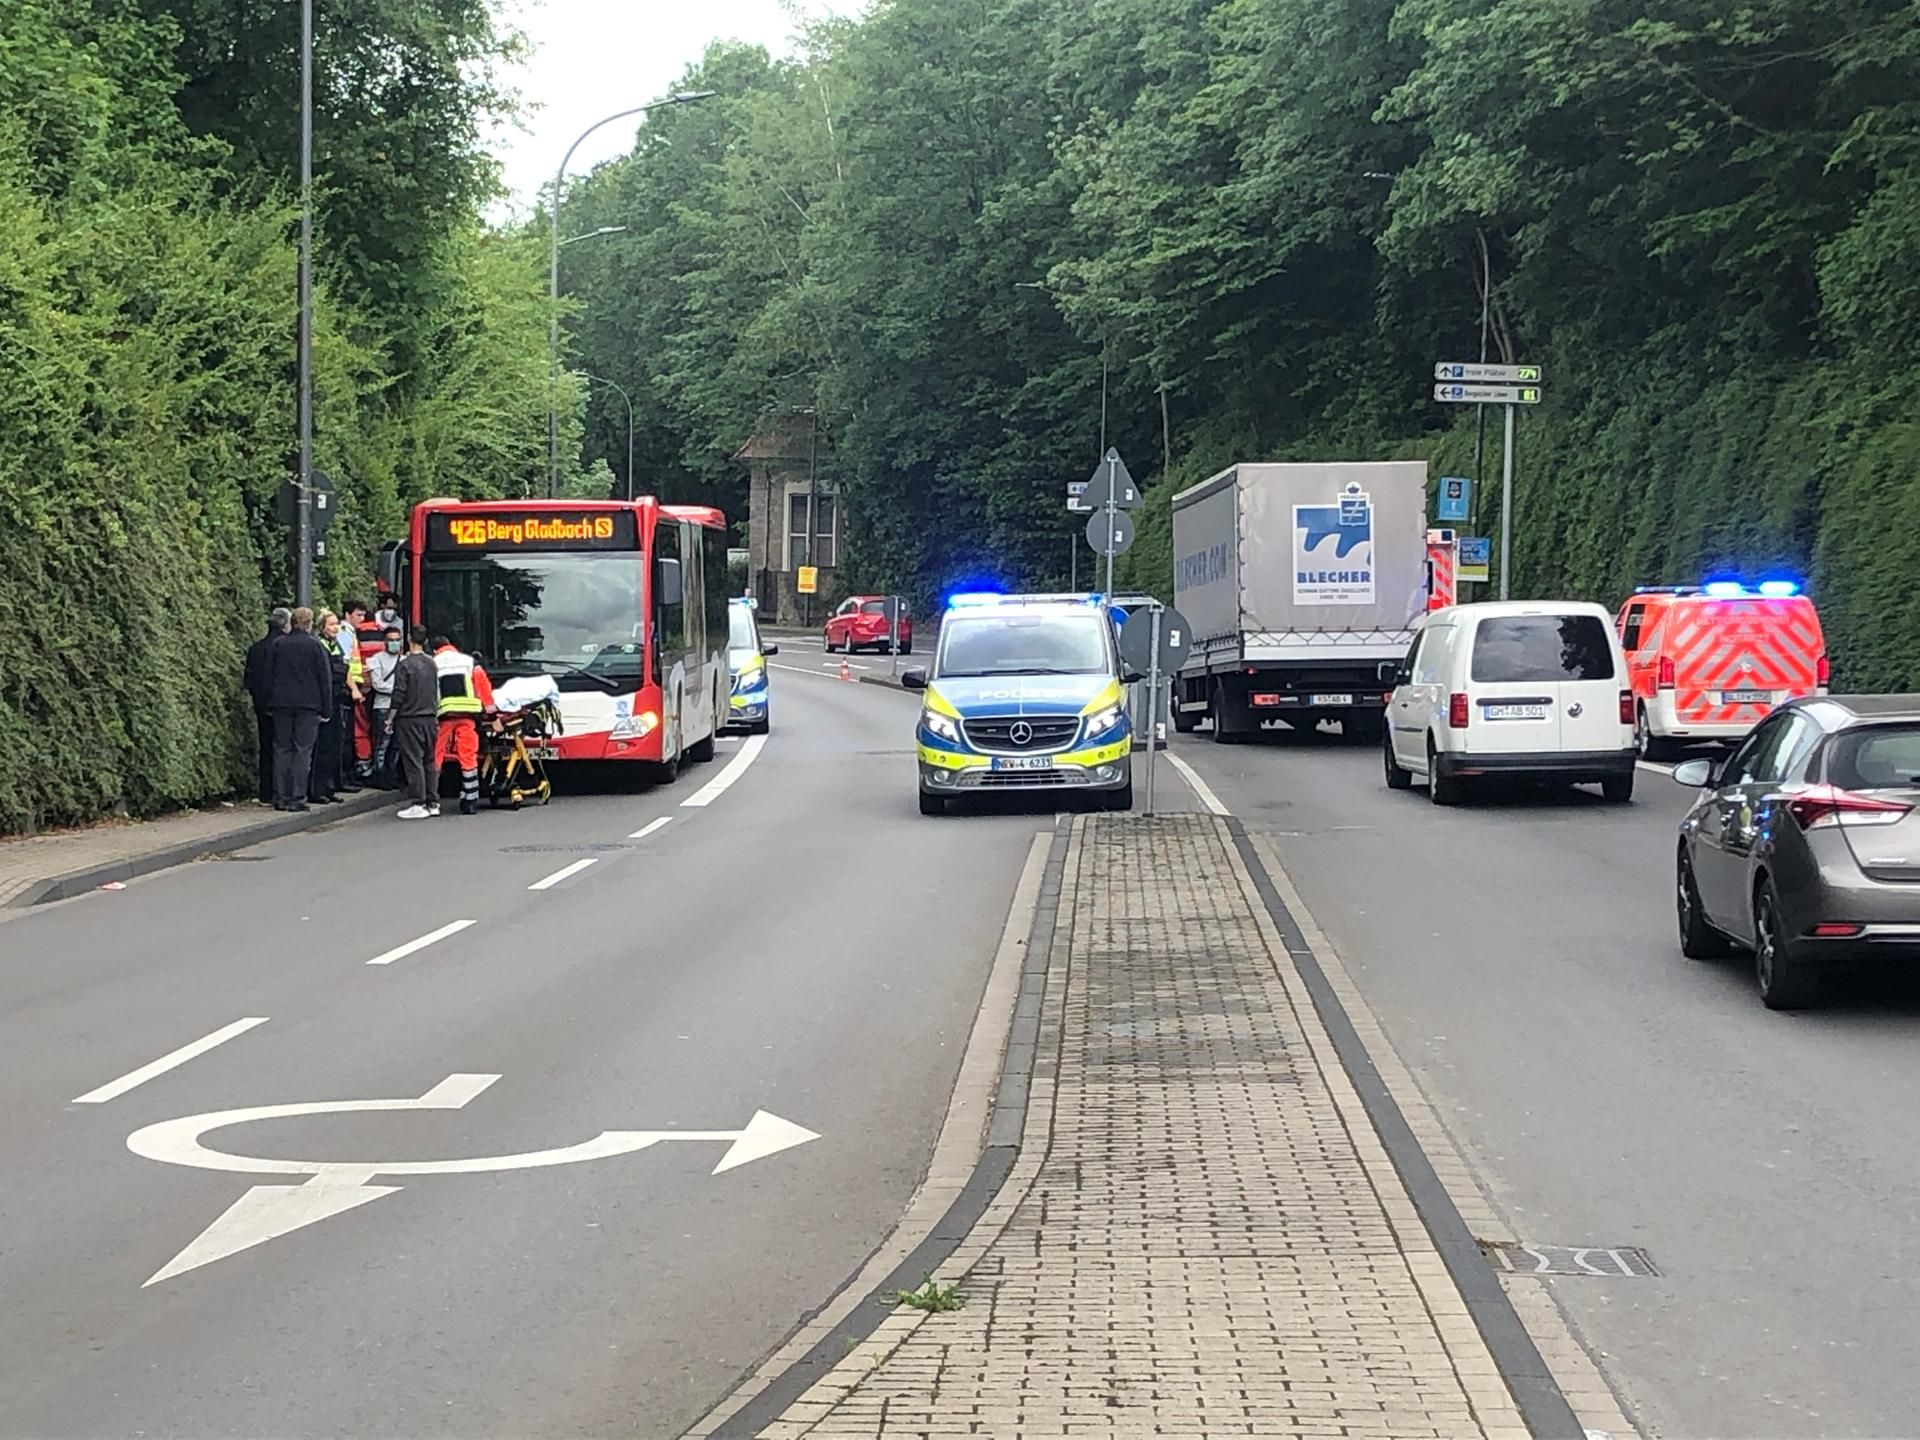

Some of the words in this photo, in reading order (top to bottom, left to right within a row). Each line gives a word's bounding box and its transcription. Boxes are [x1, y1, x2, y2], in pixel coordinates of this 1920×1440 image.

[450, 520, 486, 544] 426
[487, 521, 523, 543] Berg
[525, 518, 592, 539] Gladbach
[1297, 570, 1371, 583] BLECHER
